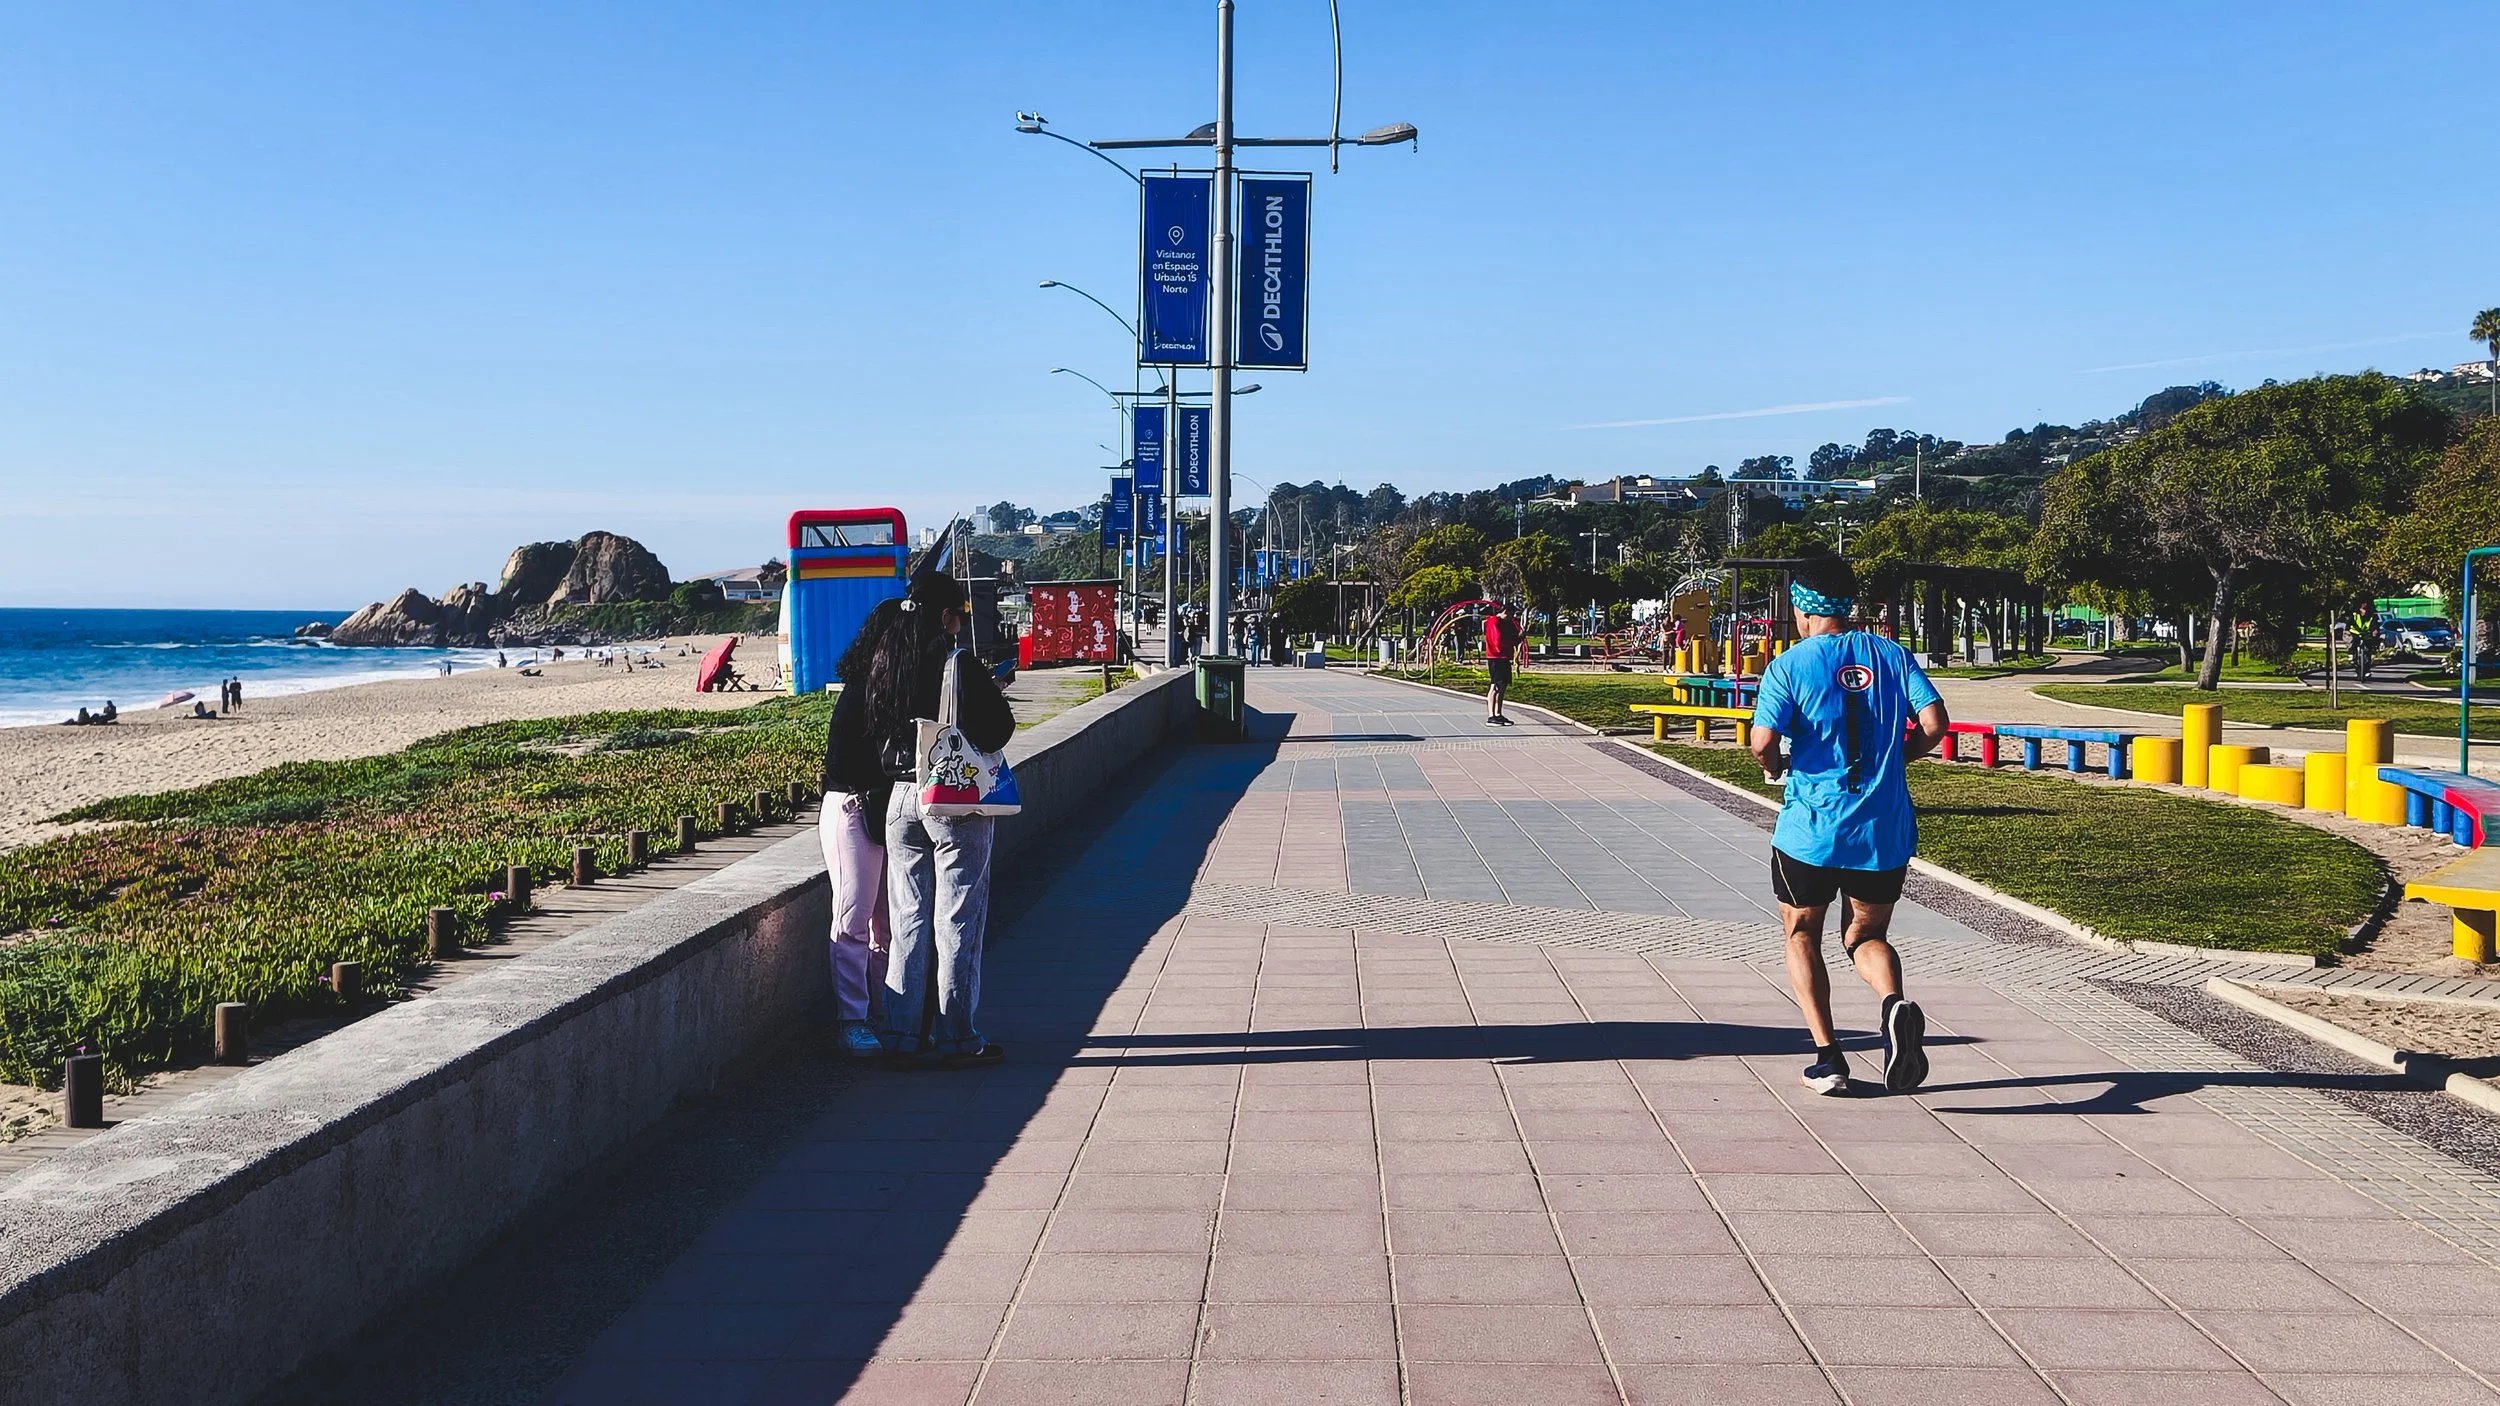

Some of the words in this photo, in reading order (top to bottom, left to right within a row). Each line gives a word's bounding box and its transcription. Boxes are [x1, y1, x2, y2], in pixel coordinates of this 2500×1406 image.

[1164, 261, 1199, 272] Espacio
[1264, 196, 1283, 319] DECATHLON
[1154, 272, 1186, 282] Urbano
[1187, 273, 1197, 282] 15
[1190, 415, 1199, 473] DECATHLON
